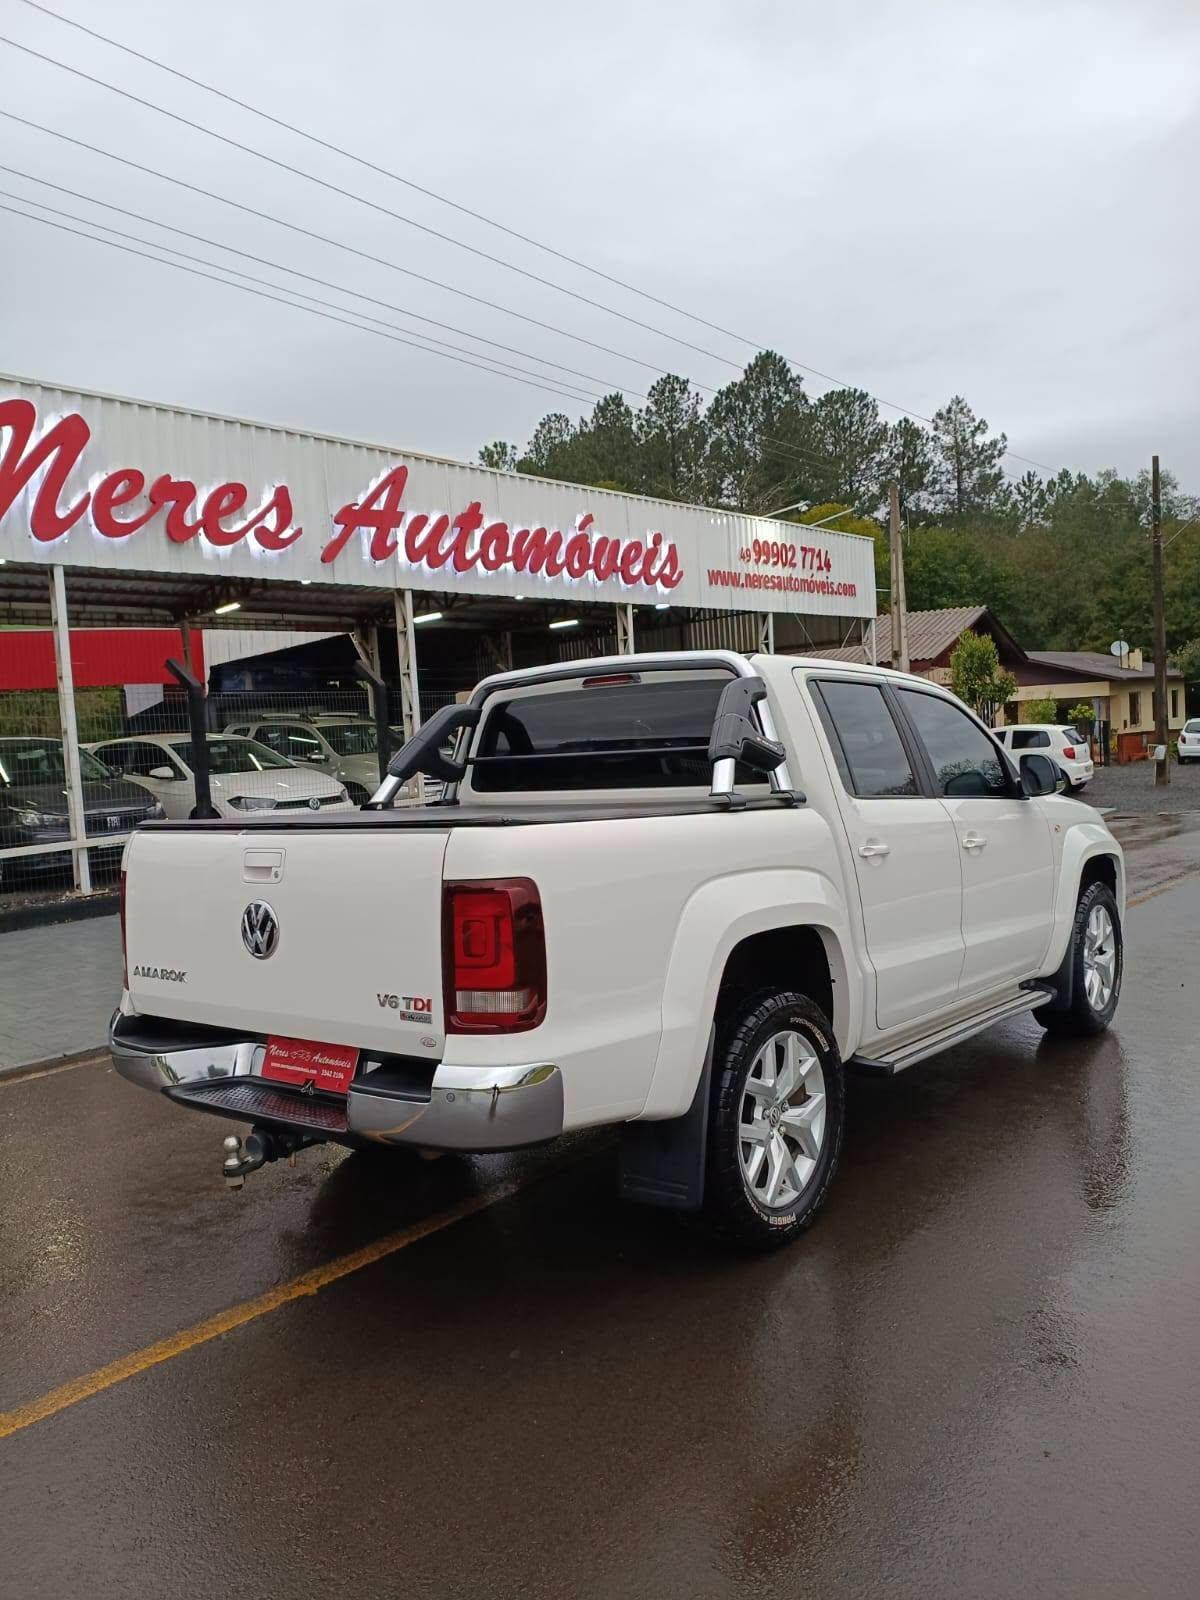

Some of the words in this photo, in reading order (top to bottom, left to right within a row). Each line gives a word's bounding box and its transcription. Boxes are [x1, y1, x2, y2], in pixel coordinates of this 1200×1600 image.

[0, 399, 302, 547] Neres
[321, 465, 683, 589] Automóveis
[740, 547, 751, 563] 49
[752, 538, 797, 569] 99902
[800, 546, 832, 572] 7714
[707, 569, 857, 597] www.neresautomóveis.com
[133, 966, 187, 983] AMAROK
[377, 993, 400, 1009] V6
[402, 997, 432, 1012] TDI
